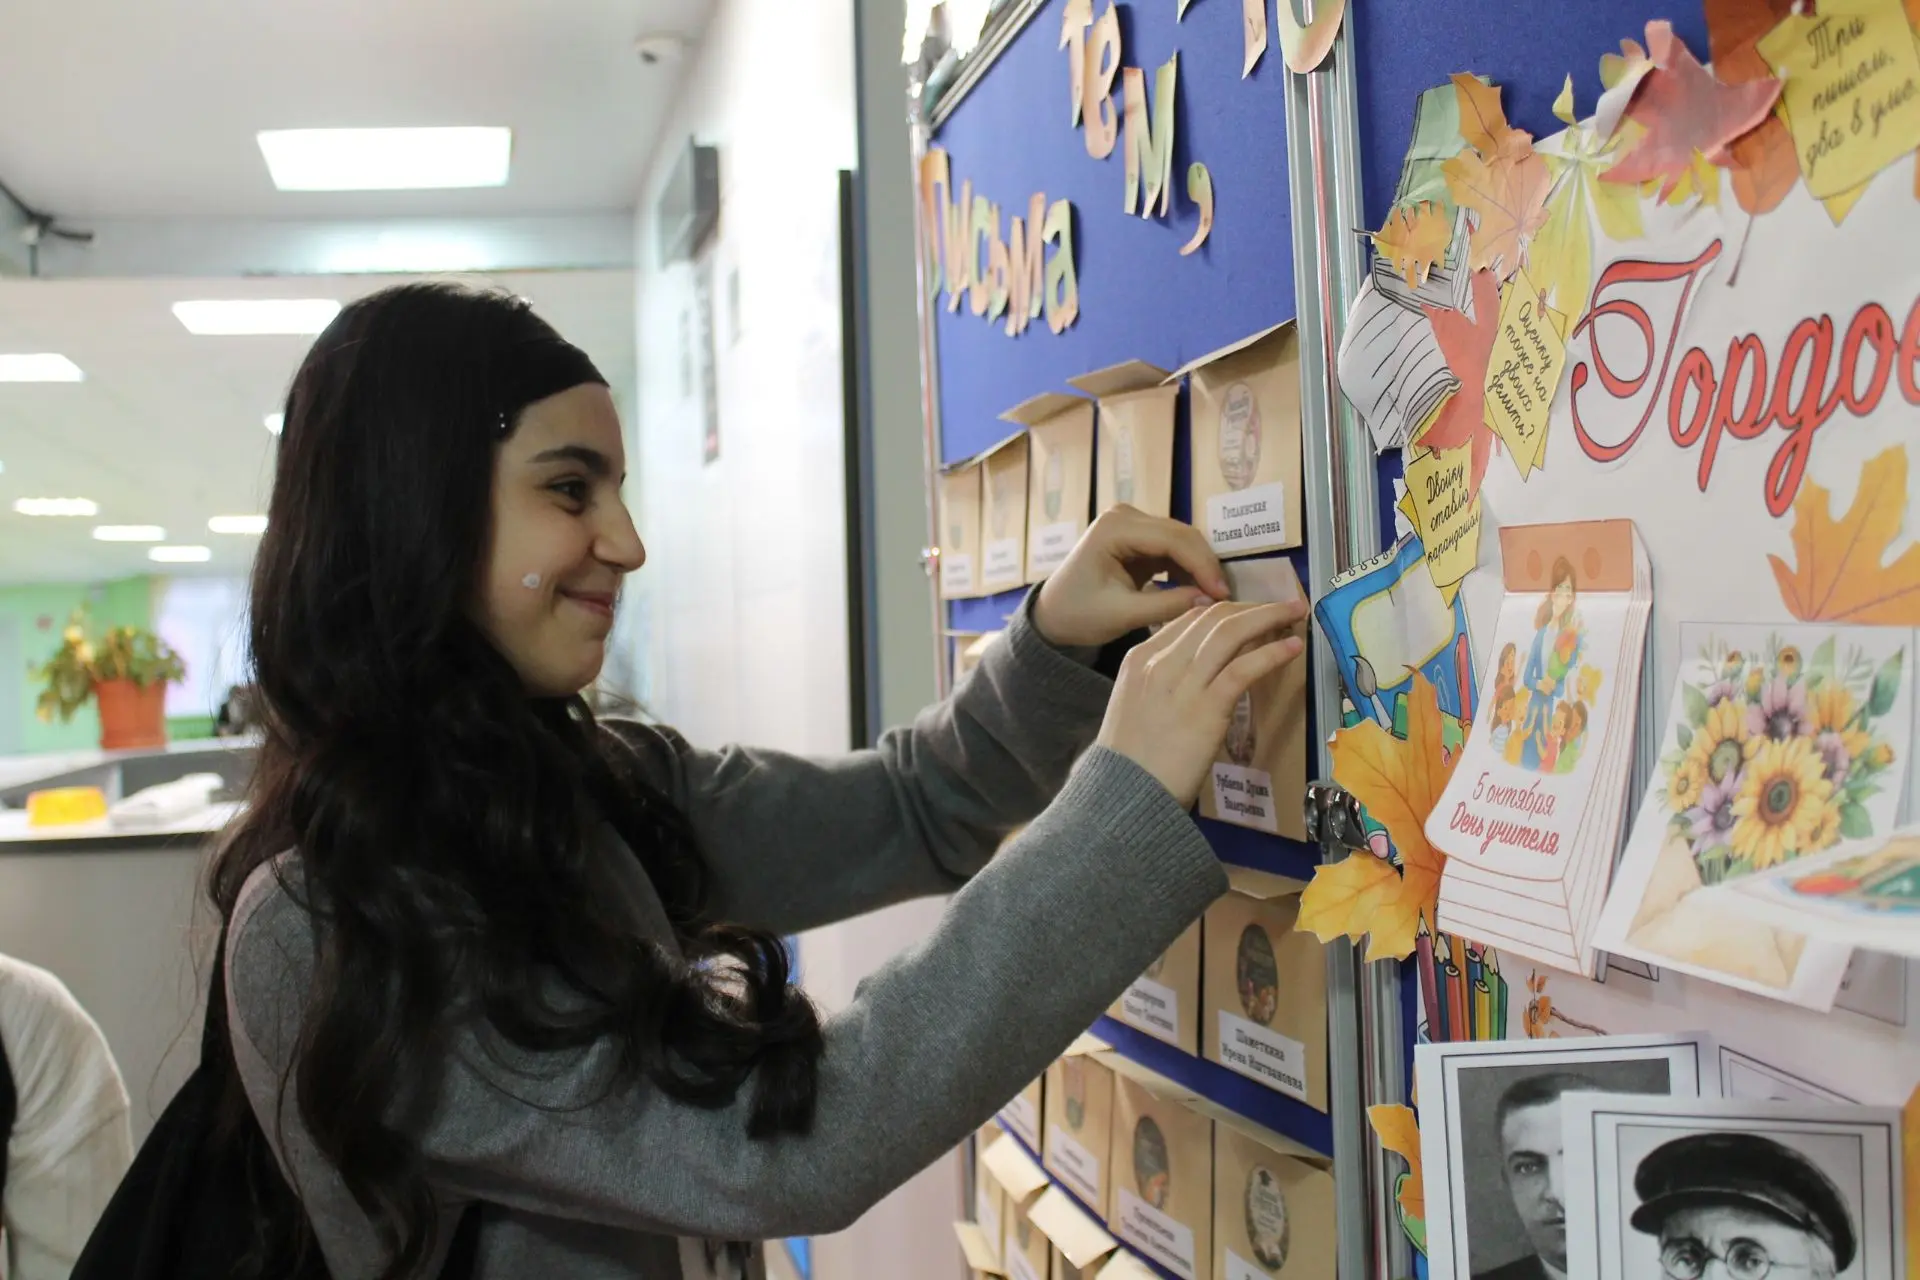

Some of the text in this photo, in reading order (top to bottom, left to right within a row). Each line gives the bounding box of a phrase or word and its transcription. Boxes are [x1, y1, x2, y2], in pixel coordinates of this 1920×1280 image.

[920, 147, 1079, 337] Письма
[1505, 324, 1547, 402] тоже на
[1518, 300, 1553, 374] Оценку
[1499, 360, 1533, 412] двоих
[1426, 461, 1464, 504] Двойку
[1212, 521, 1281, 543] Татьяна Олеговна
[1430, 487, 1469, 532] ставлю
[1472, 771, 1556, 822] 5 октября
[1450, 801, 1560, 856] День учителя
